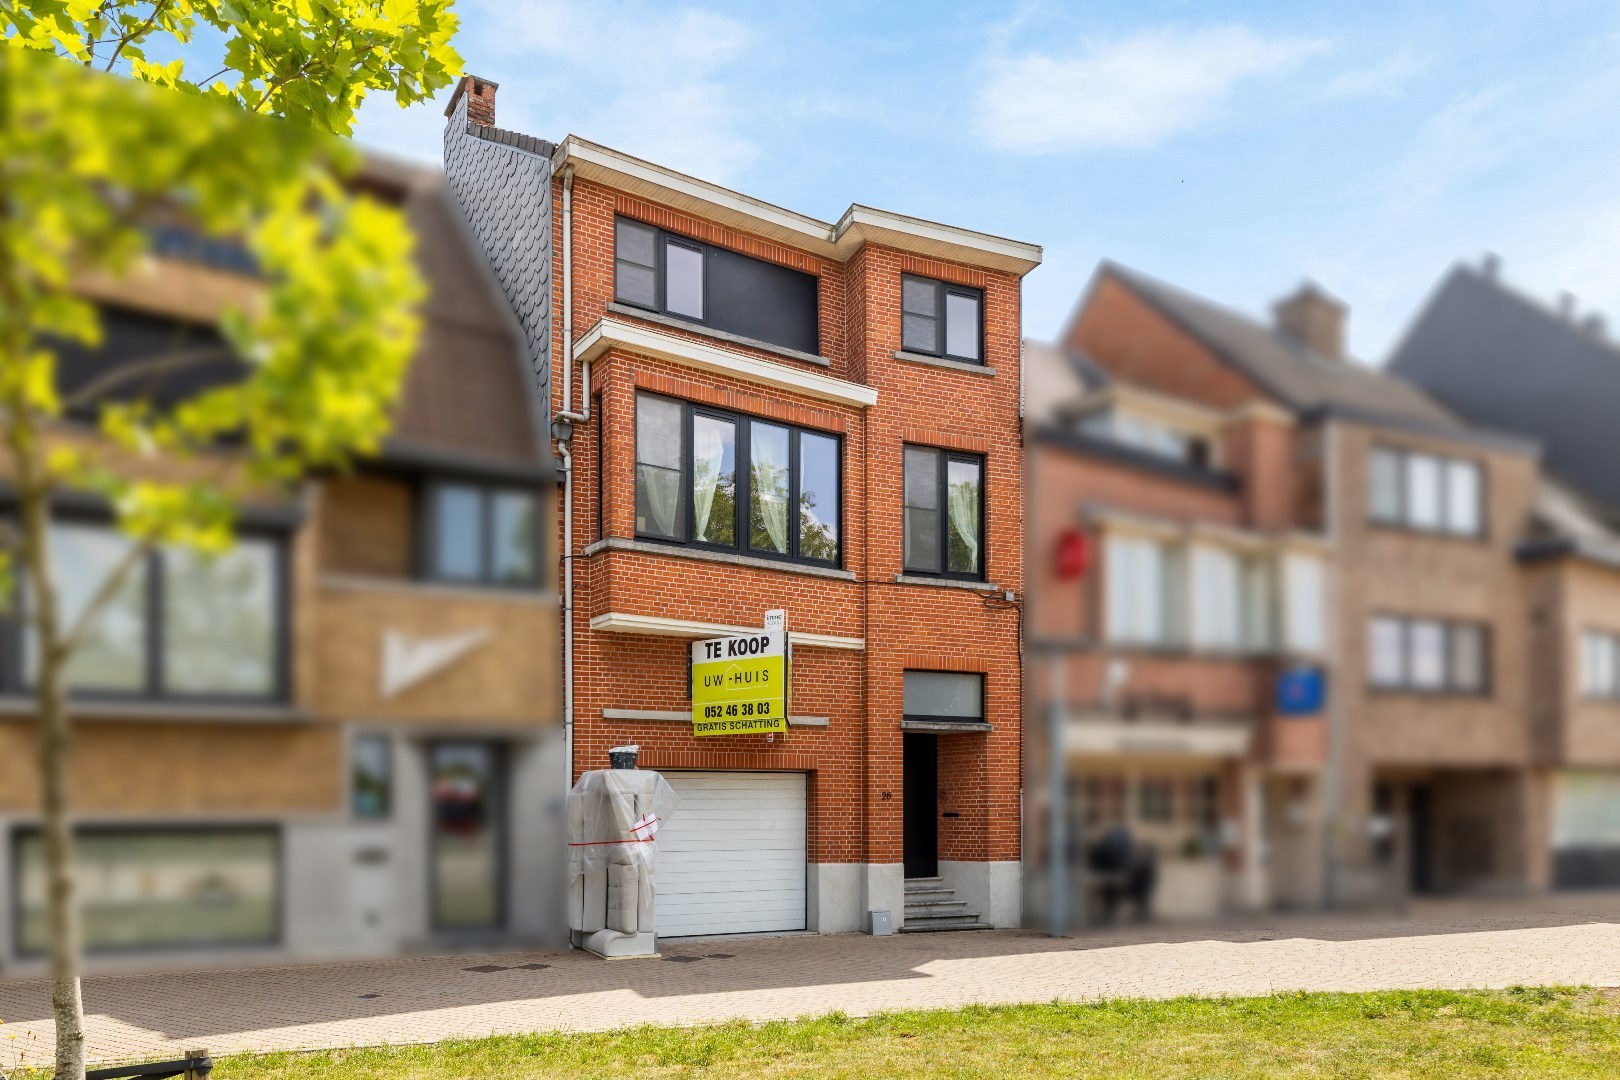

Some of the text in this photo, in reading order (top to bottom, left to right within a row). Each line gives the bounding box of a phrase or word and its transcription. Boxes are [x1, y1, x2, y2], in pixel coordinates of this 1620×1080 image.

[705, 636, 770, 659] TE KOOP
[704, 702, 770, 719] 052 46 38 03
[696, 719, 780, 732] GRATIS SCHATTING
